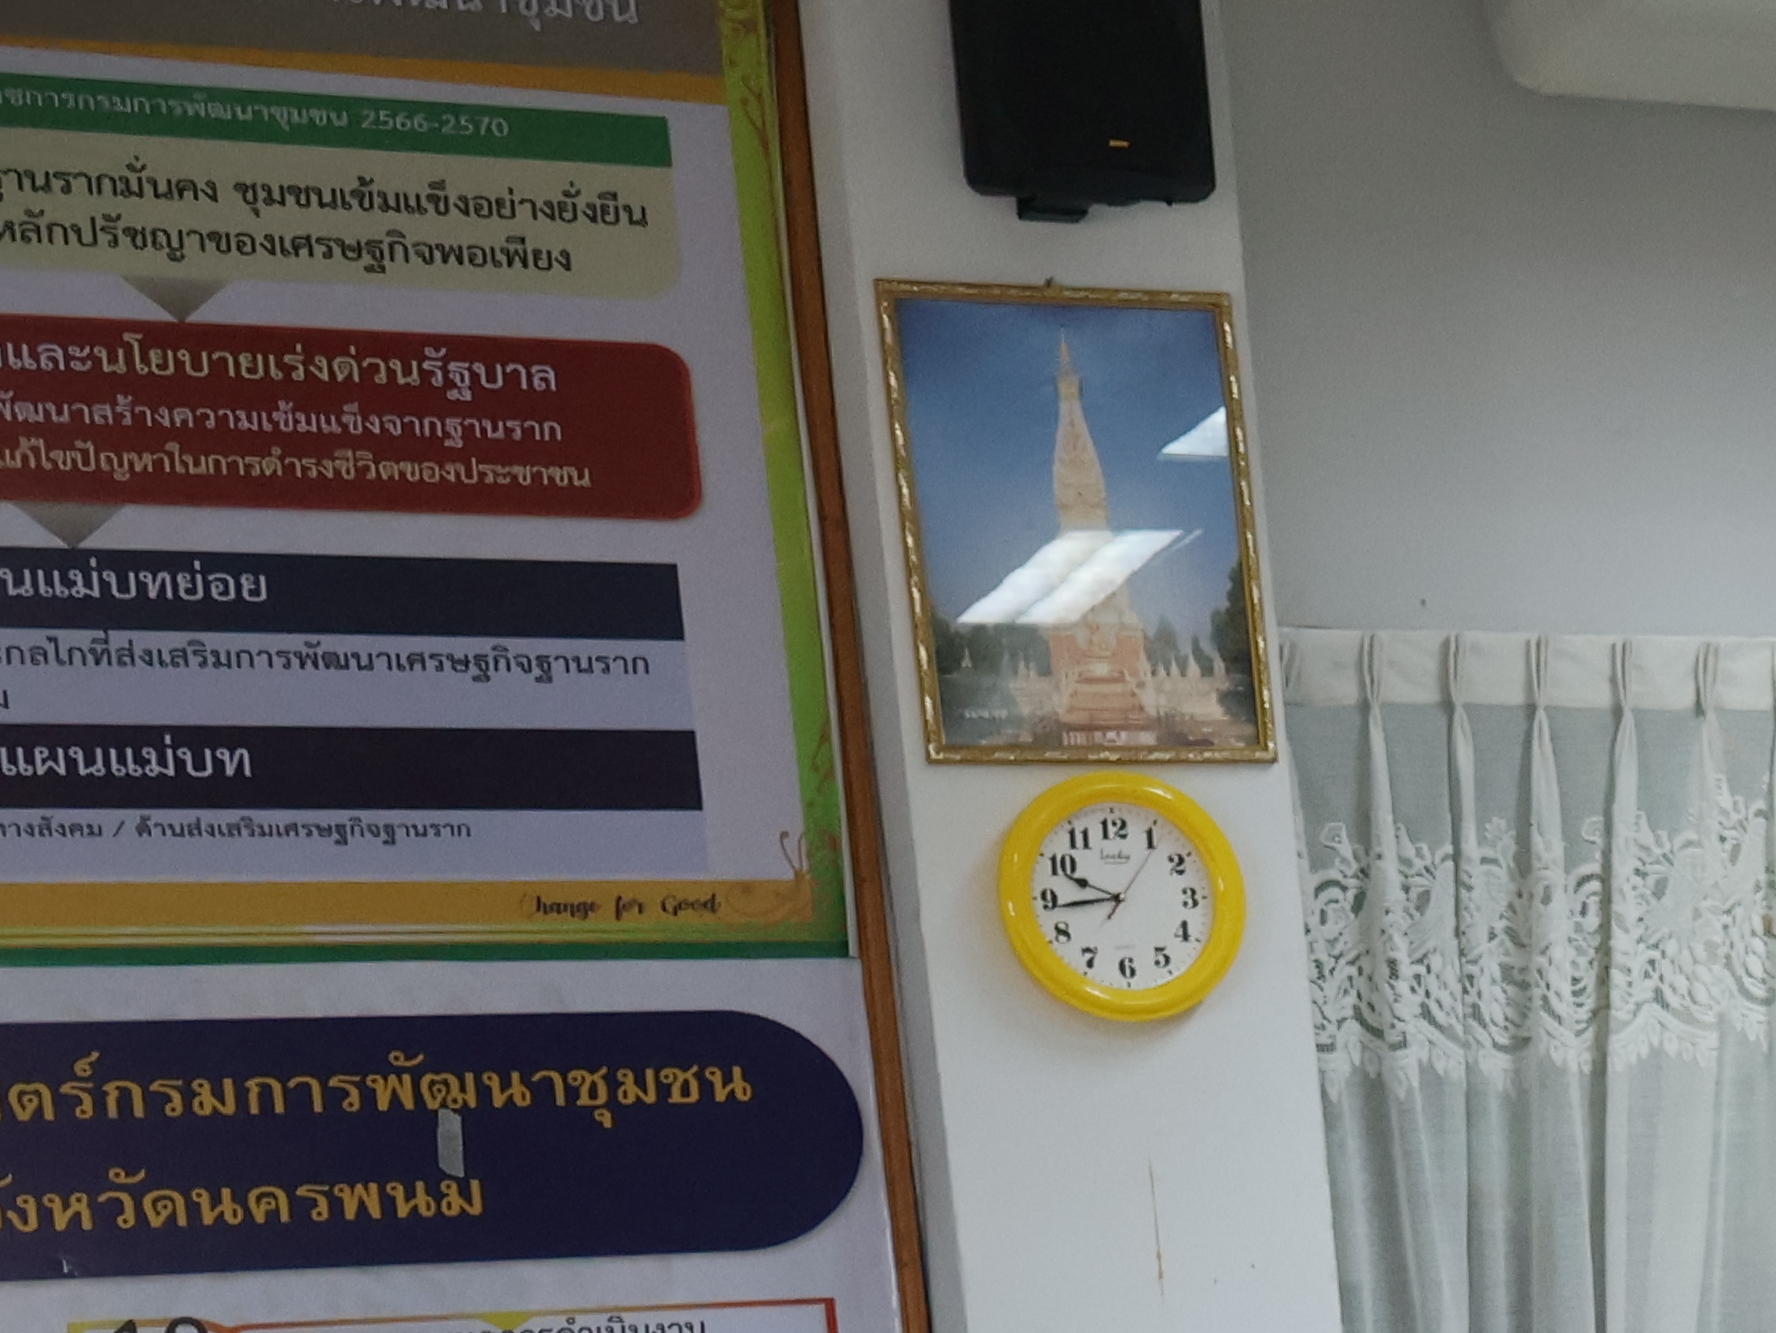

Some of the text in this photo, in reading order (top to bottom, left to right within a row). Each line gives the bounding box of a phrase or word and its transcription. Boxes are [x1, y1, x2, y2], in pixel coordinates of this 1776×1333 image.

[0, 88, 509, 137] ชการกรมการพัฒนาชุมชน 2566-2570
[0, 155, 648, 228] านรากมั่นคง ชุมชนเข้มแข็งอย่างยั่งยืน
[0, 334, 557, 400] และนโยบายเร่งด่วนรัฐบาล
[0, 630, 650, 682] กลไกที่ส่งเสริมการพัฒนาเศรษฐกิจฐานราก
[0, 734, 251, 777] แผนแม่บท
[1067, 827, 1092, 850] 11
[1099, 817, 1129, 840] 12
[1145, 827, 1157, 850] 1
[1049, 853, 1077, 877] 10
[1168, 853, 1187, 876] 2
[661, 893, 719, 915] Good
[1040, 888, 1059, 911] 9
[1182, 887, 1199, 909] 3
[1054, 921, 1071, 943] 8
[1174, 920, 1191, 942] 4
[1081, 946, 1098, 969] 7
[1118, 957, 1136, 979] 6
[1154, 947, 1171, 968] 5
[0, 1166, 484, 1233] งหวัดนครพนม
